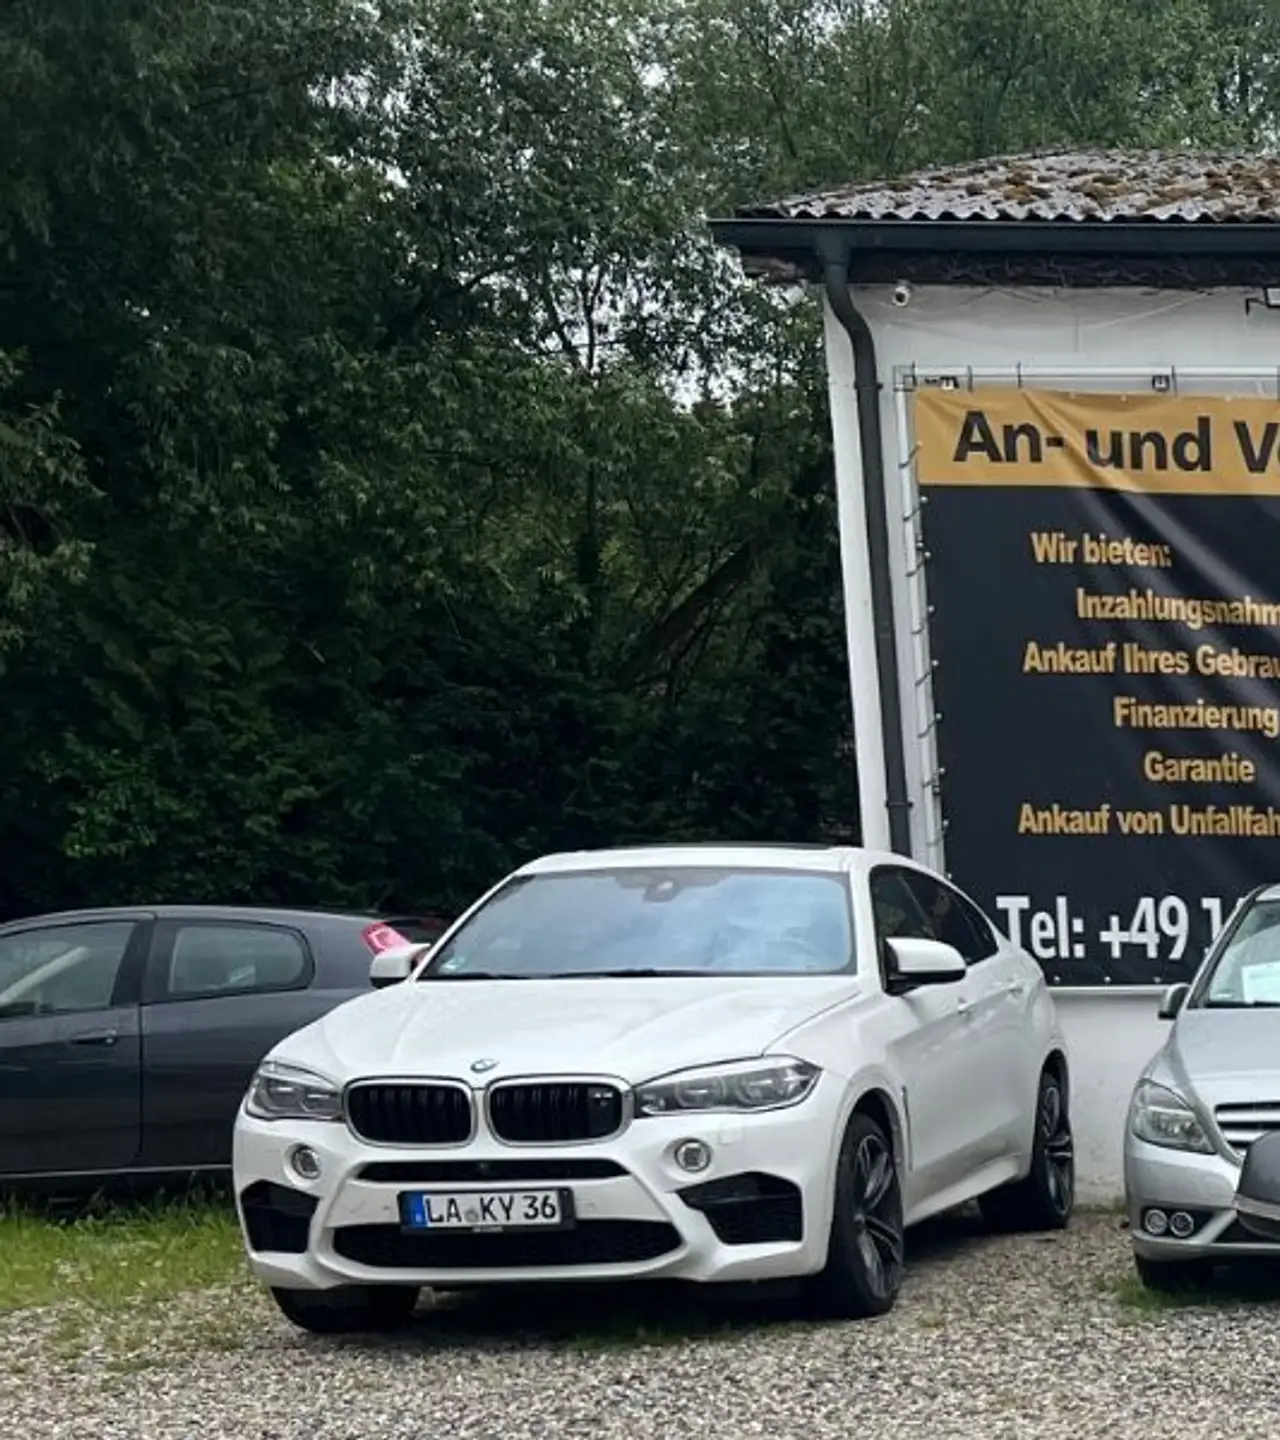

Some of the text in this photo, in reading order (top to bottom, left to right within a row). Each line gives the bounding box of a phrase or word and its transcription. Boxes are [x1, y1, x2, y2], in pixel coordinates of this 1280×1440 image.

[954, 410, 1064, 464] An-
[1087, 417, 1211, 472] und
[1031, 532, 1172, 568] Wir bieten:
[1023, 643, 1116, 674] Ankauf
[1123, 646, 1188, 674] Ihres
[1113, 696, 1280, 738] Finanzierung
[1144, 752, 1255, 782] Garantie
[1018, 804, 1110, 835] Ankauf
[1119, 811, 1163, 835] von
[996, 895, 1086, 959] Tel:
[1100, 895, 1190, 959] +49
[424, 1195, 556, 1223] LA KY 36
